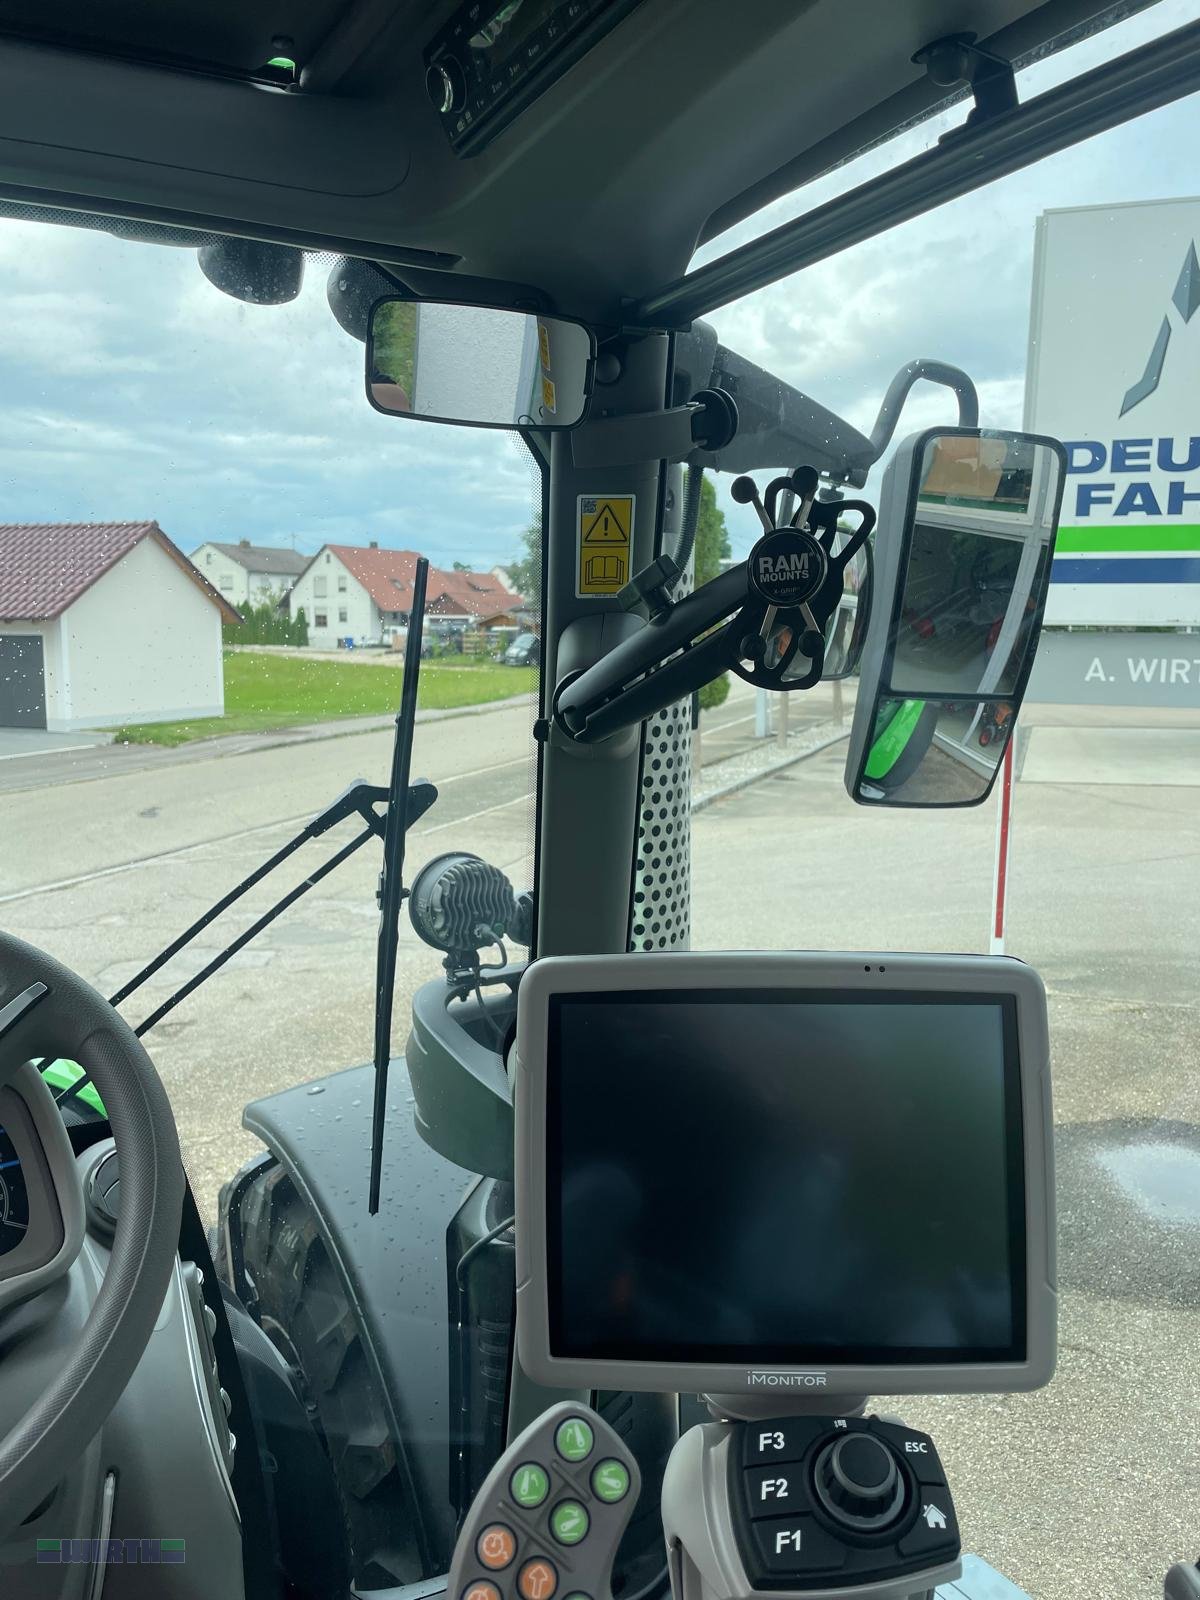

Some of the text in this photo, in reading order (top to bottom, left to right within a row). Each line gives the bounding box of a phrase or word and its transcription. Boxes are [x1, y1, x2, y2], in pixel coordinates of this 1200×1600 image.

[1063, 437, 1200, 474] DEU
[759, 553, 809, 573] RAM
[760, 570, 809, 583] MOUNTS
[1084, 657, 1116, 682] A.
[759, 1431, 785, 1451] F3
[905, 1441, 928, 1453] ESC
[761, 1478, 788, 1500] F2
[776, 1529, 802, 1553] F1
